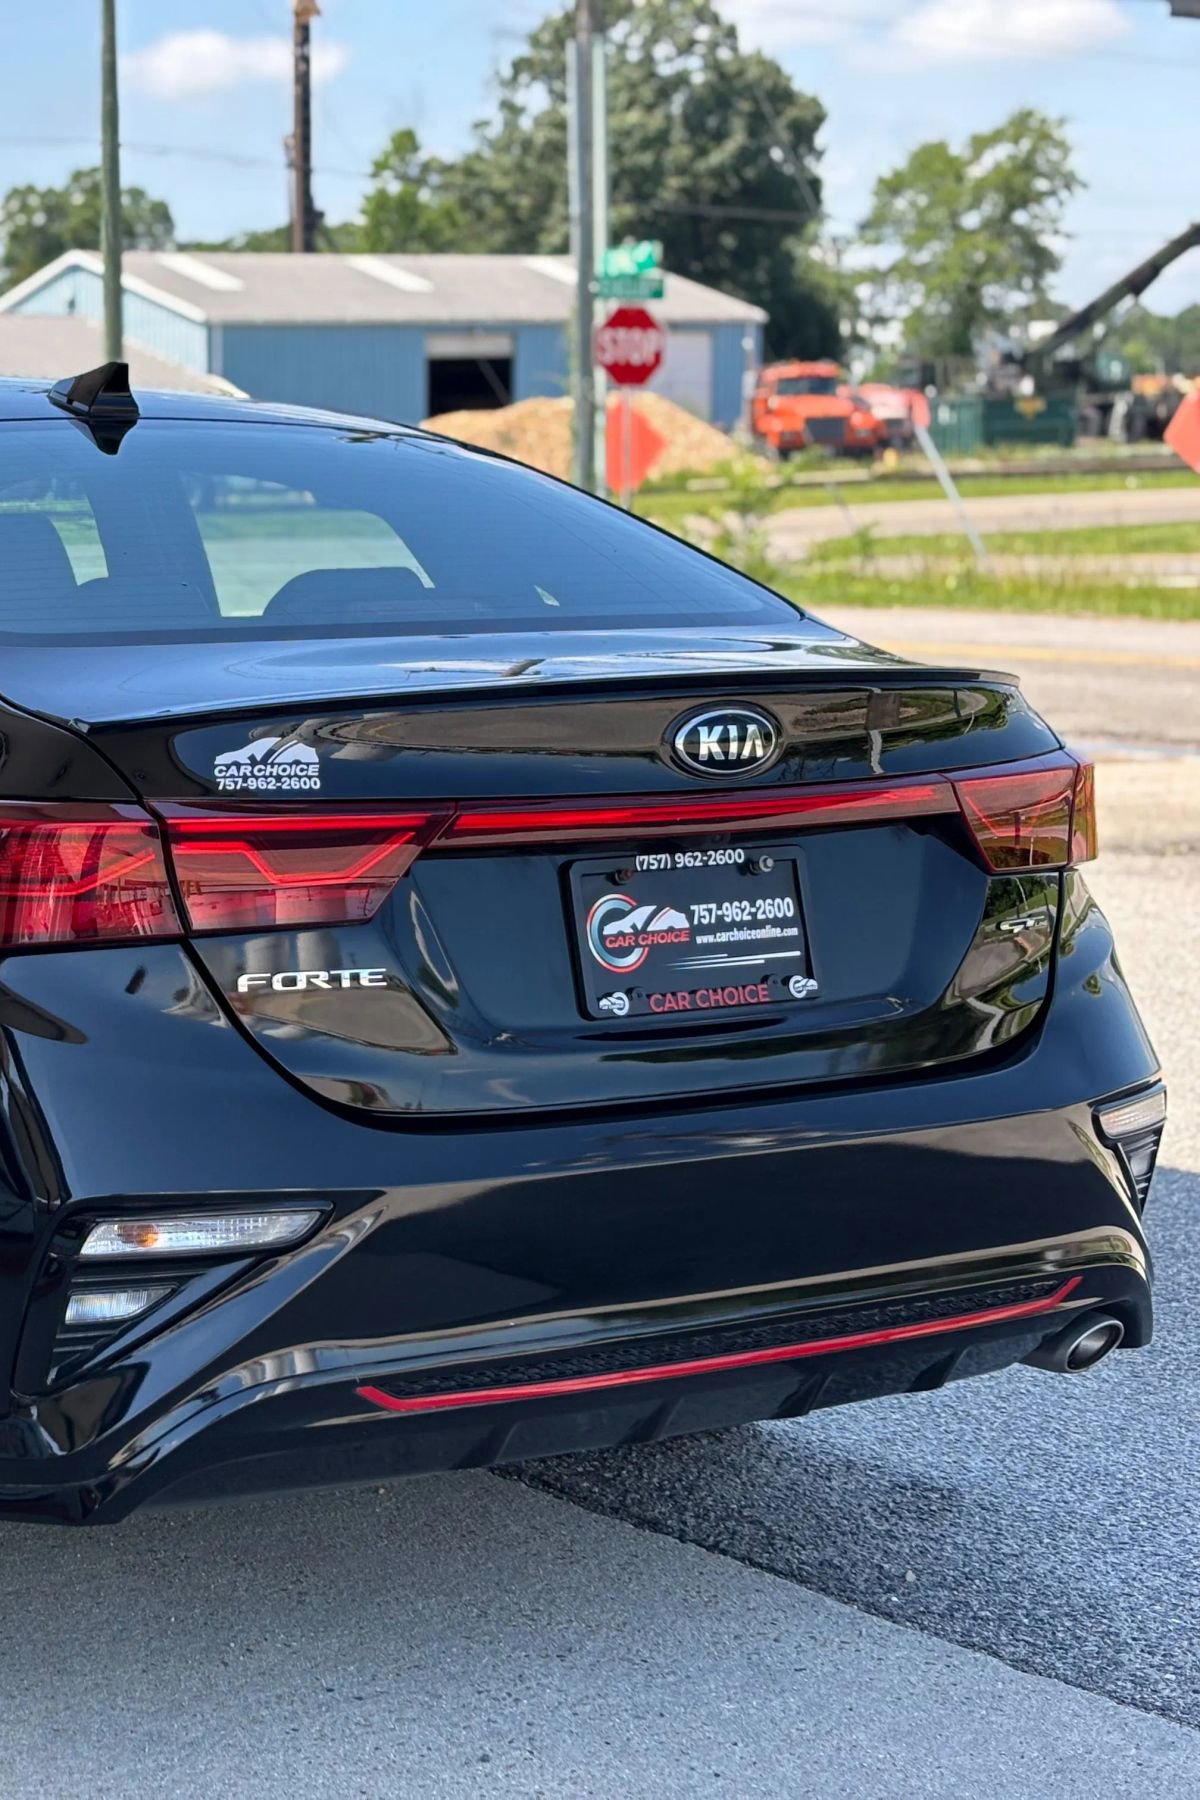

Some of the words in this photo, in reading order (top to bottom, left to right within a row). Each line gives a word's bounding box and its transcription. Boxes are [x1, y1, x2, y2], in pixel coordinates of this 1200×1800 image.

[697, 724, 764, 761] KIA
[214, 764, 252, 777] CAR
[253, 764, 320, 777] CHOICE
[216, 777, 321, 790] 757-962-2600
[635, 853, 672, 872] (757)
[674, 849, 745, 868] 962-2600
[690, 896, 794, 926] 757-962-2600
[604, 933, 636, 949] CAR
[638, 929, 691, 946] CHOICE
[695, 924, 799, 945] www.carchoiceonline.com
[237, 968, 388, 993] FORTE
[650, 992, 693, 1013] CAR
[695, 983, 770, 1008] CHOICE
